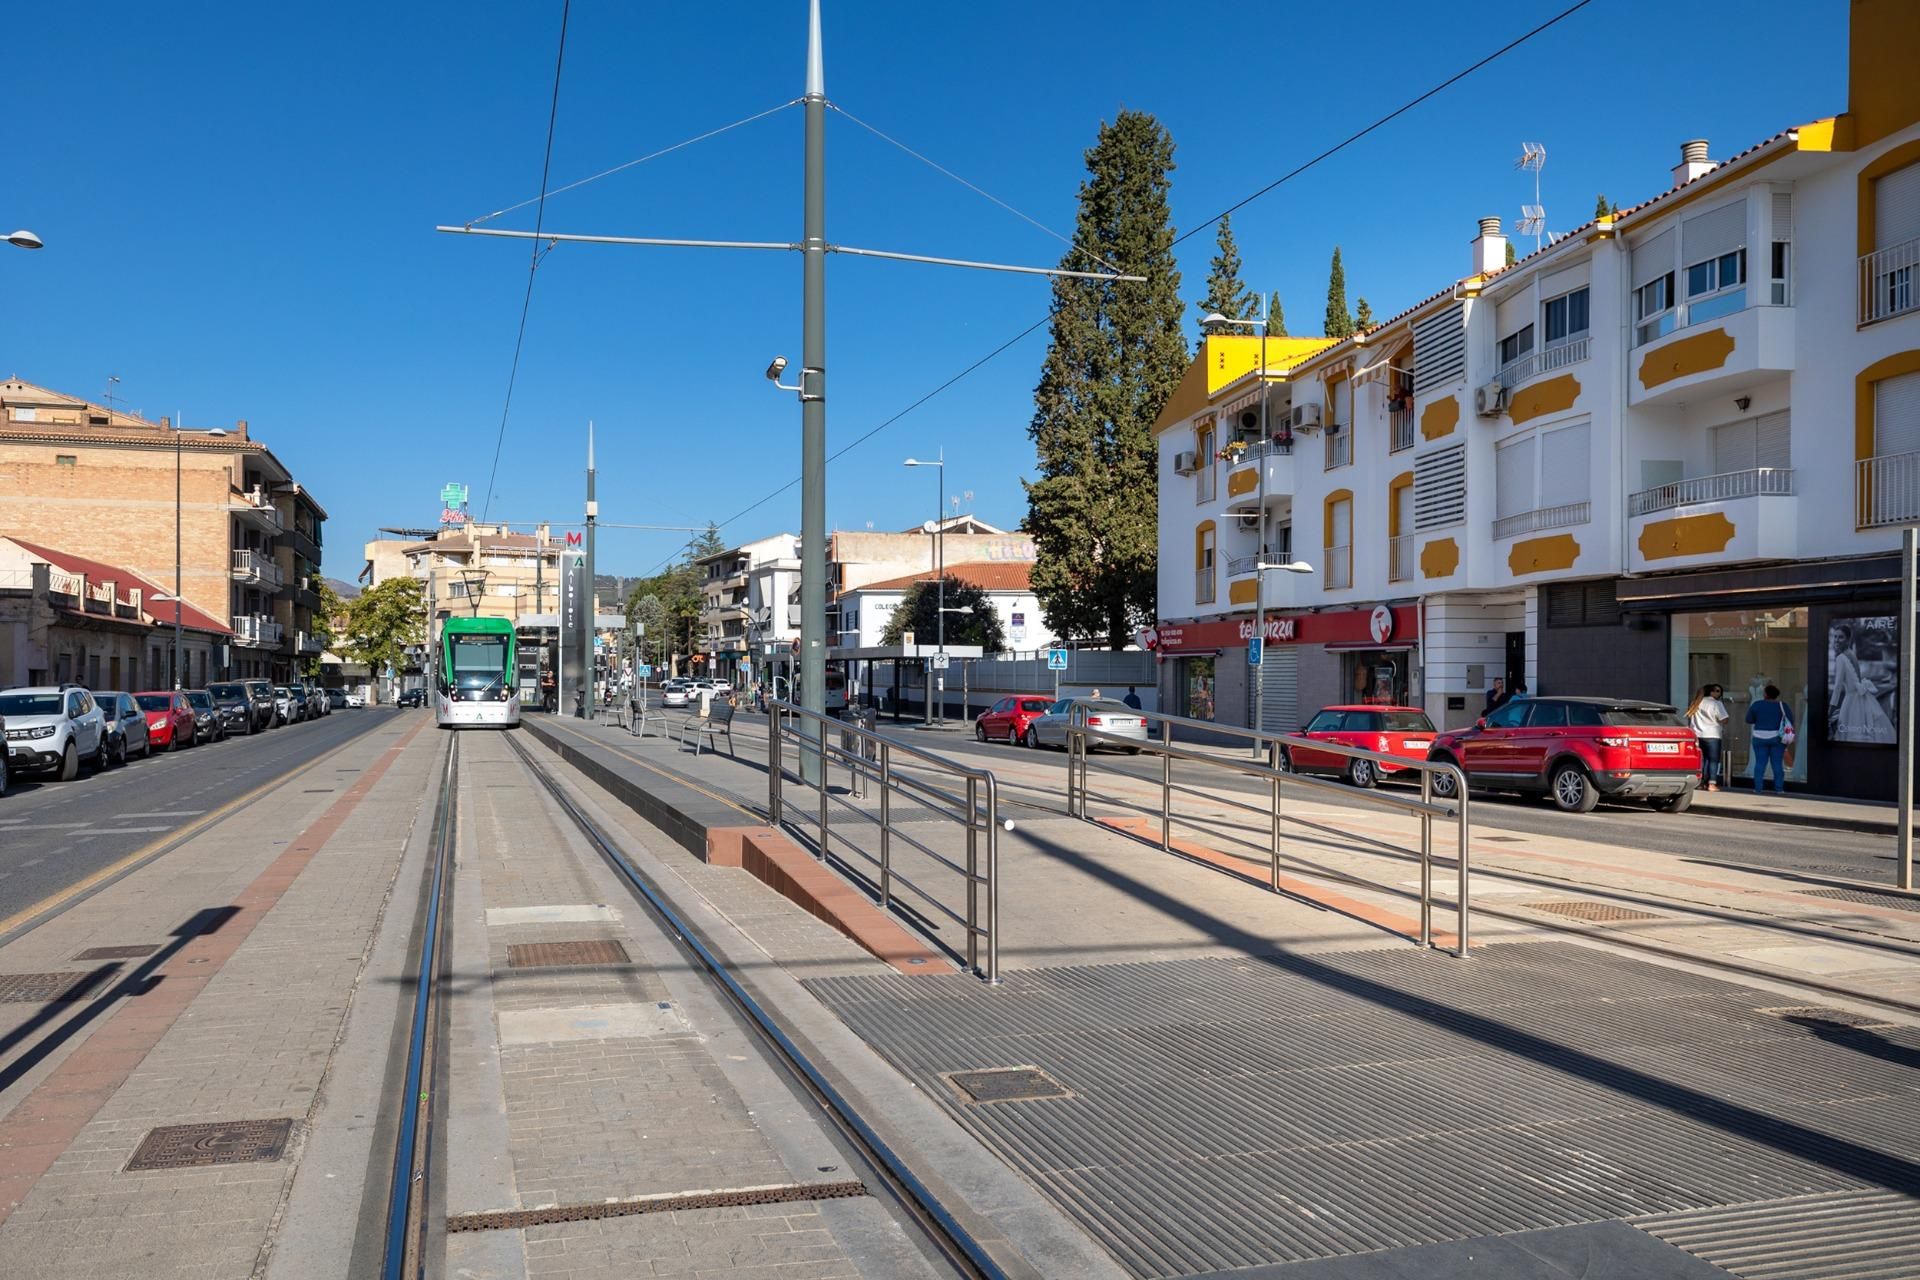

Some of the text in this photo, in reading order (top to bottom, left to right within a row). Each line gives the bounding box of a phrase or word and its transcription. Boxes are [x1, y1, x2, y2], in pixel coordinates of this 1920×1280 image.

[567, 532, 582, 546] M
[1239, 619, 1295, 640] telpizza
[1866, 619, 1895, 630] AIRE
